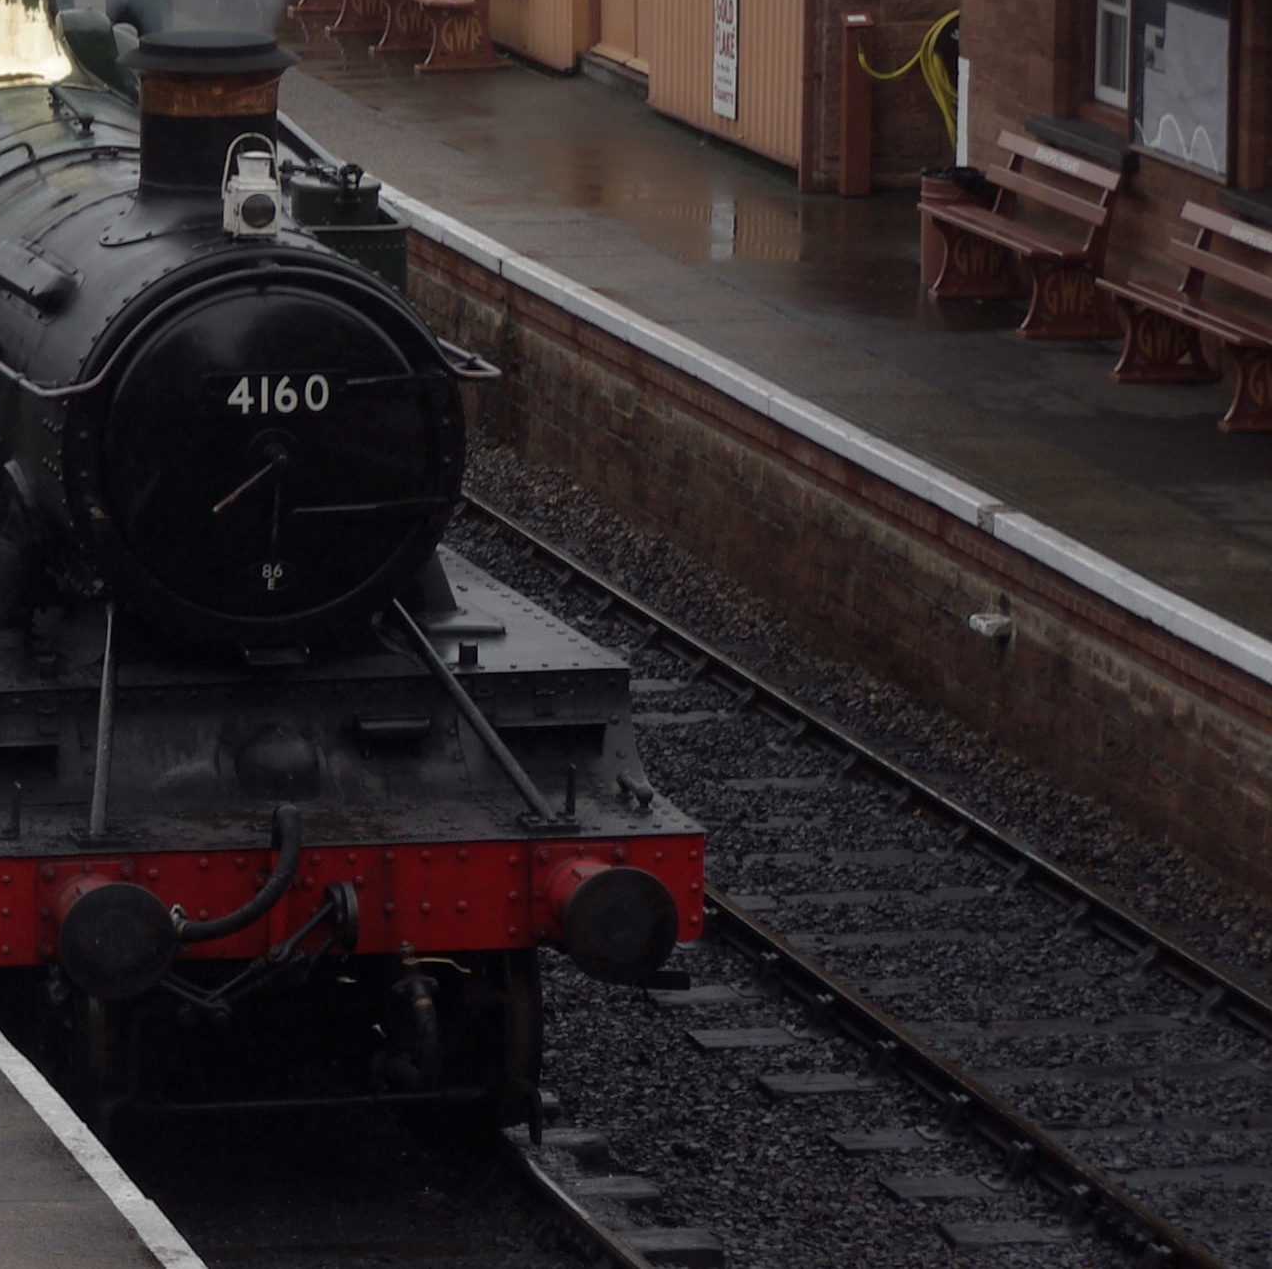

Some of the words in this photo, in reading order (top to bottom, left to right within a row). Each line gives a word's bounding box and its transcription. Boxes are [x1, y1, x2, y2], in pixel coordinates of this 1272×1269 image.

[442, 13, 483, 52] GWR
[1044, 266, 1096, 315] GWR
[227, 373, 330, 414] 4160
[262, 563, 284, 579] 86
[267, 578, 275, 590] E
